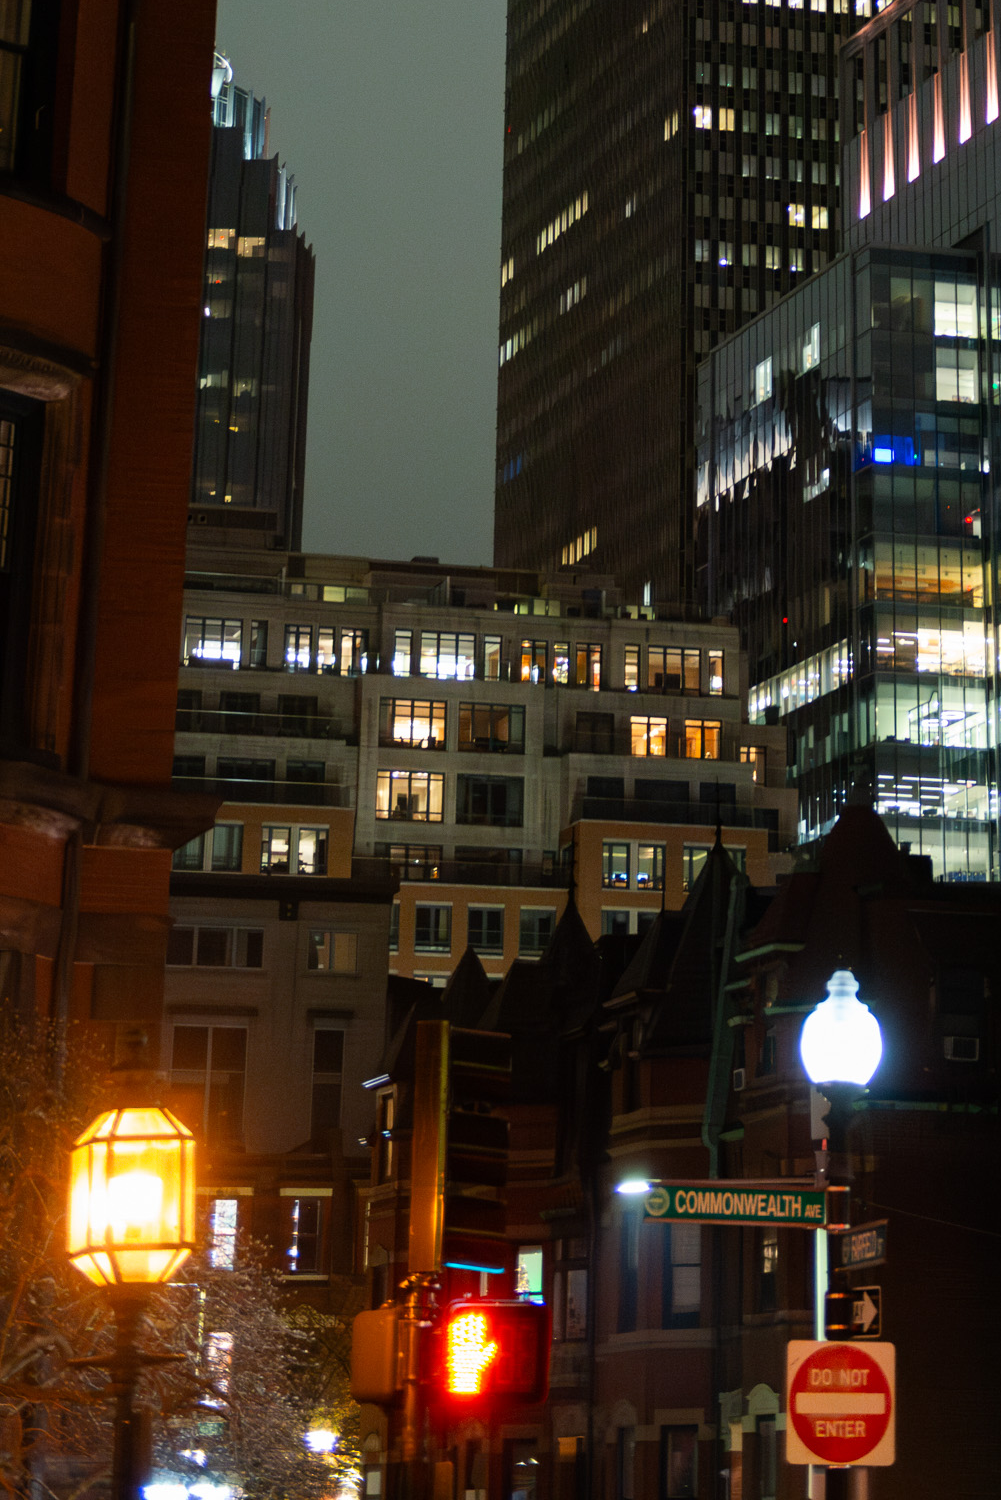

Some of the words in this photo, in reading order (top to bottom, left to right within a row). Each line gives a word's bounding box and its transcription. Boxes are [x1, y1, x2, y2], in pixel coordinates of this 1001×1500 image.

[675, 1190, 802, 1217] COMMONWEALTH
[804, 1204, 822, 1218] AVE
[811, 1368, 832, 1386] DO
[840, 1368, 870, 1386] NOT
[815, 1420, 867, 1437] ENTER
